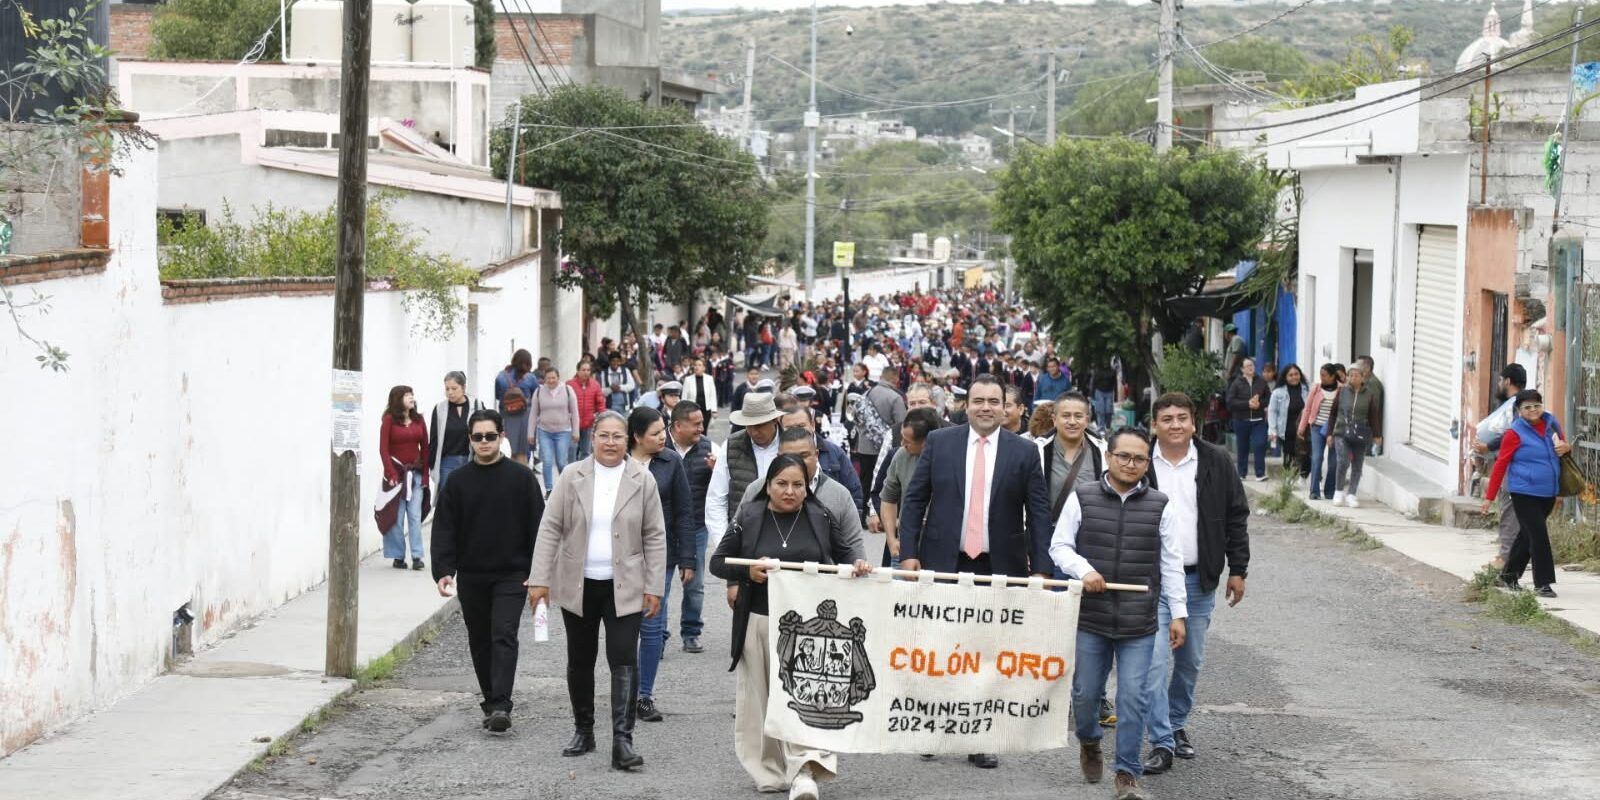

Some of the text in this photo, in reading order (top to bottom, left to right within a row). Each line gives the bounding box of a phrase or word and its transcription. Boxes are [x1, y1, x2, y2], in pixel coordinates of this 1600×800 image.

[893, 602, 1025, 625] MUNICIPIO DE
[889, 645, 1065, 680] COLÓN QRO
[889, 697, 1050, 718] ADMINISTRACIÓN
[887, 716, 993, 735] 2024-2027
